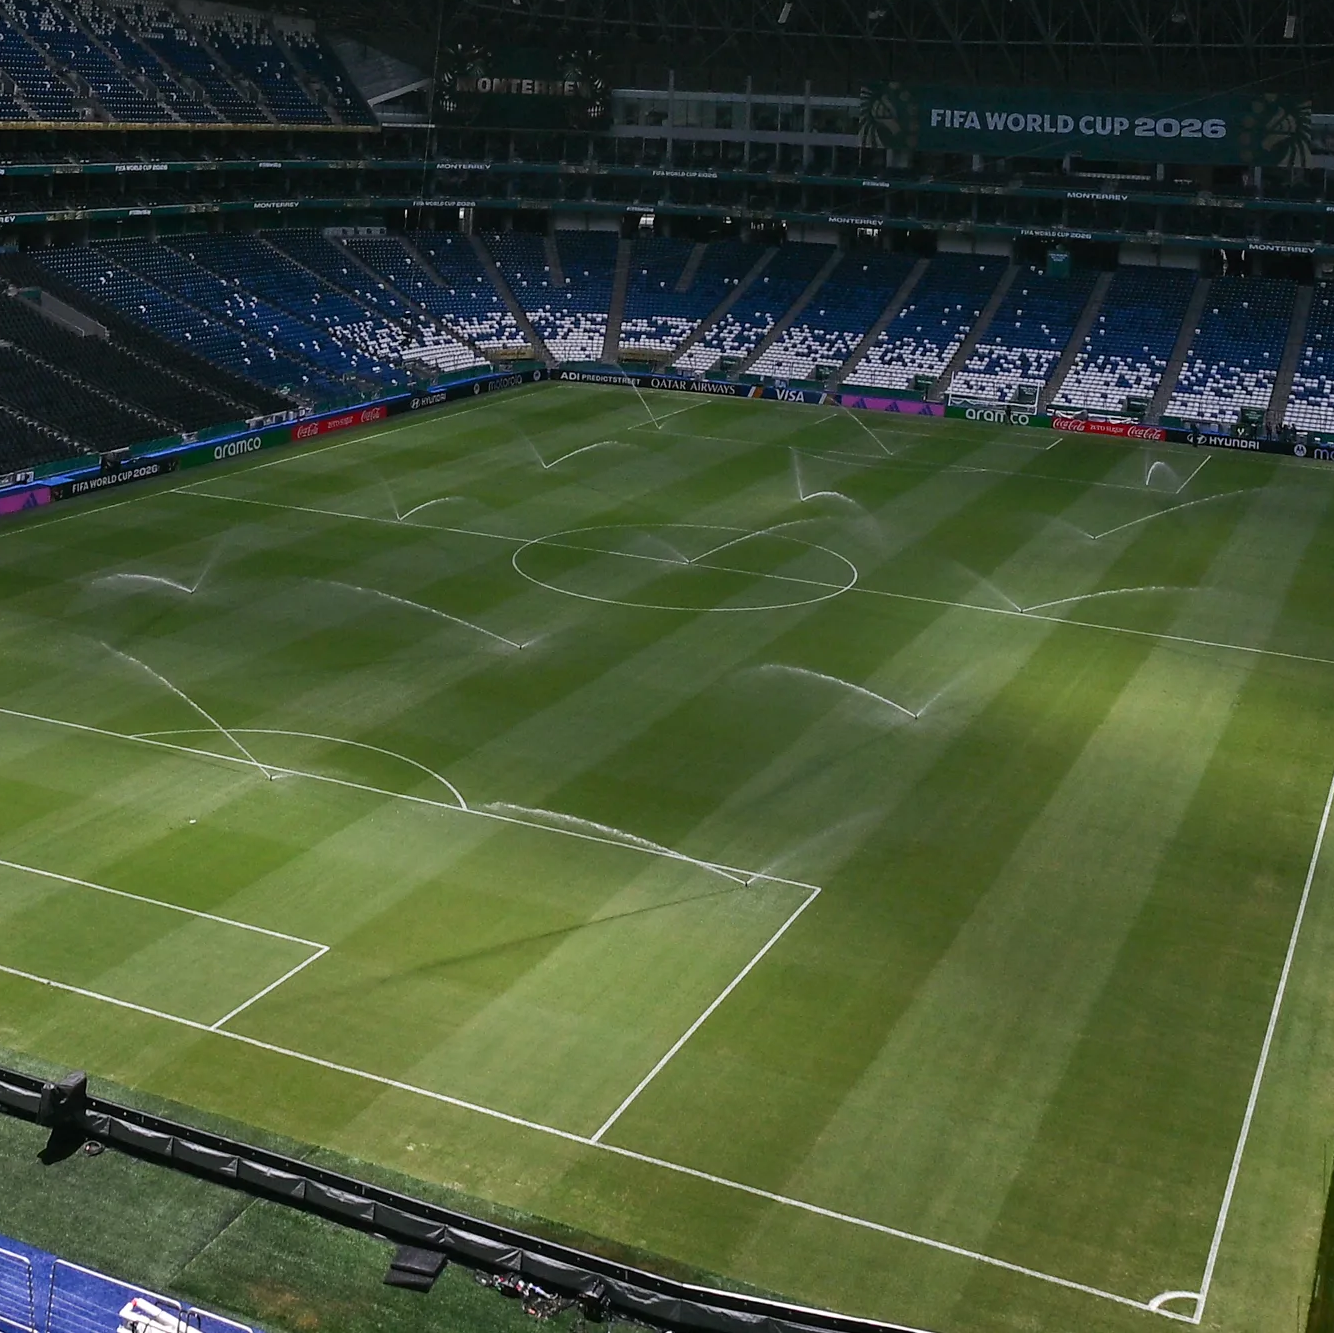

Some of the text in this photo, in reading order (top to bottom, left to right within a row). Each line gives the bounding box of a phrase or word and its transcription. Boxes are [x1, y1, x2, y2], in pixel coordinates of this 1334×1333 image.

[456, 77, 591, 96] MONTERREY
[930, 108, 1227, 139] FIFA WORLD CUP 2026
[1067, 192, 1128, 201] MONTERREY
[254, 201, 299, 209] MONTERREY
[828, 217, 884, 226] MONTERREY
[1248, 243, 1315, 254] MONTERREY
[488, 374, 523, 392] motorola
[560, 371, 641, 385] ADI PREDICTSTREET
[650, 377, 735, 395] QATAR AIRWAYS
[421, 393, 447, 407] HYUNDAI
[775, 388, 805, 403] VISA
[214, 436, 262, 460] aramco
[1208, 436, 1260, 450] HYUNDAI
[72, 464, 159, 494] FIFA WORLD CUP 2026
